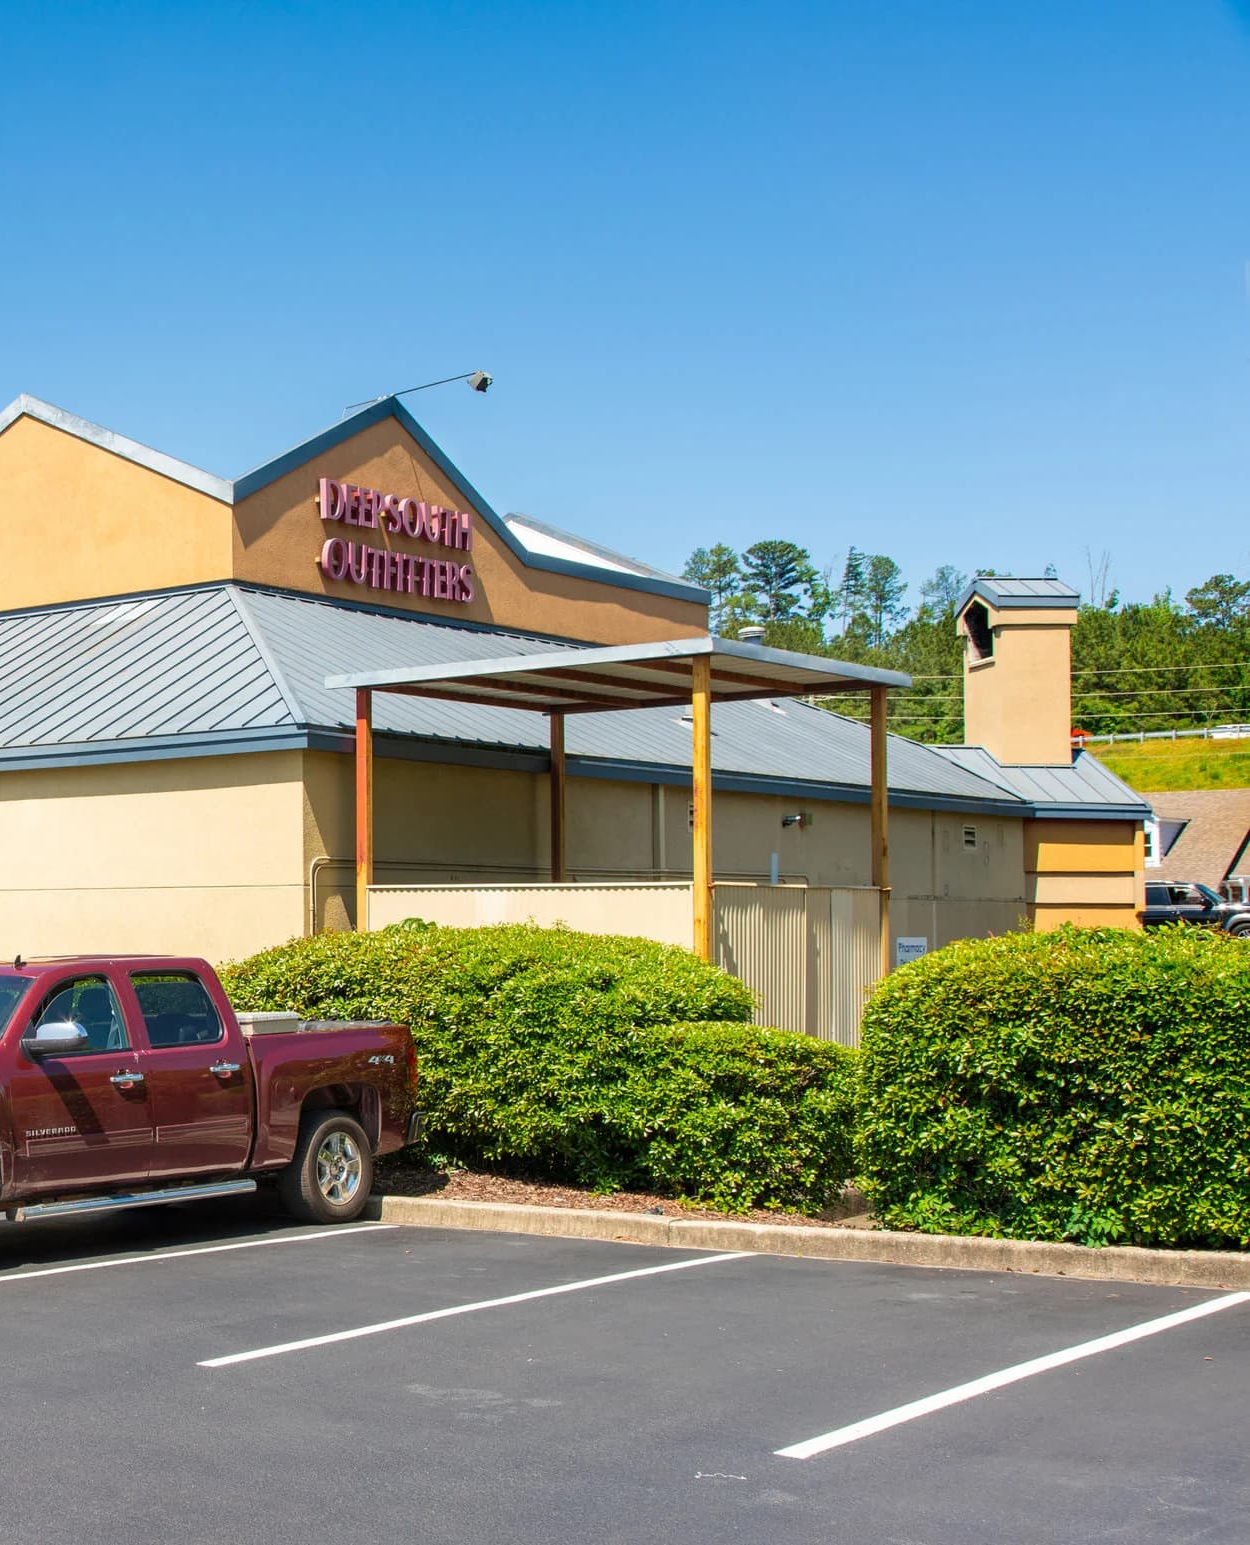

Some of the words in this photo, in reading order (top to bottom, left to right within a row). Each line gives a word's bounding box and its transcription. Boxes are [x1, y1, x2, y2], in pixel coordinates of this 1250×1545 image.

[319, 477, 383, 529] DEEP
[384, 494, 473, 551] SOUTH
[321, 537, 475, 603] OUTFITTERS
[25, 1125, 77, 1137] SILVERADO
